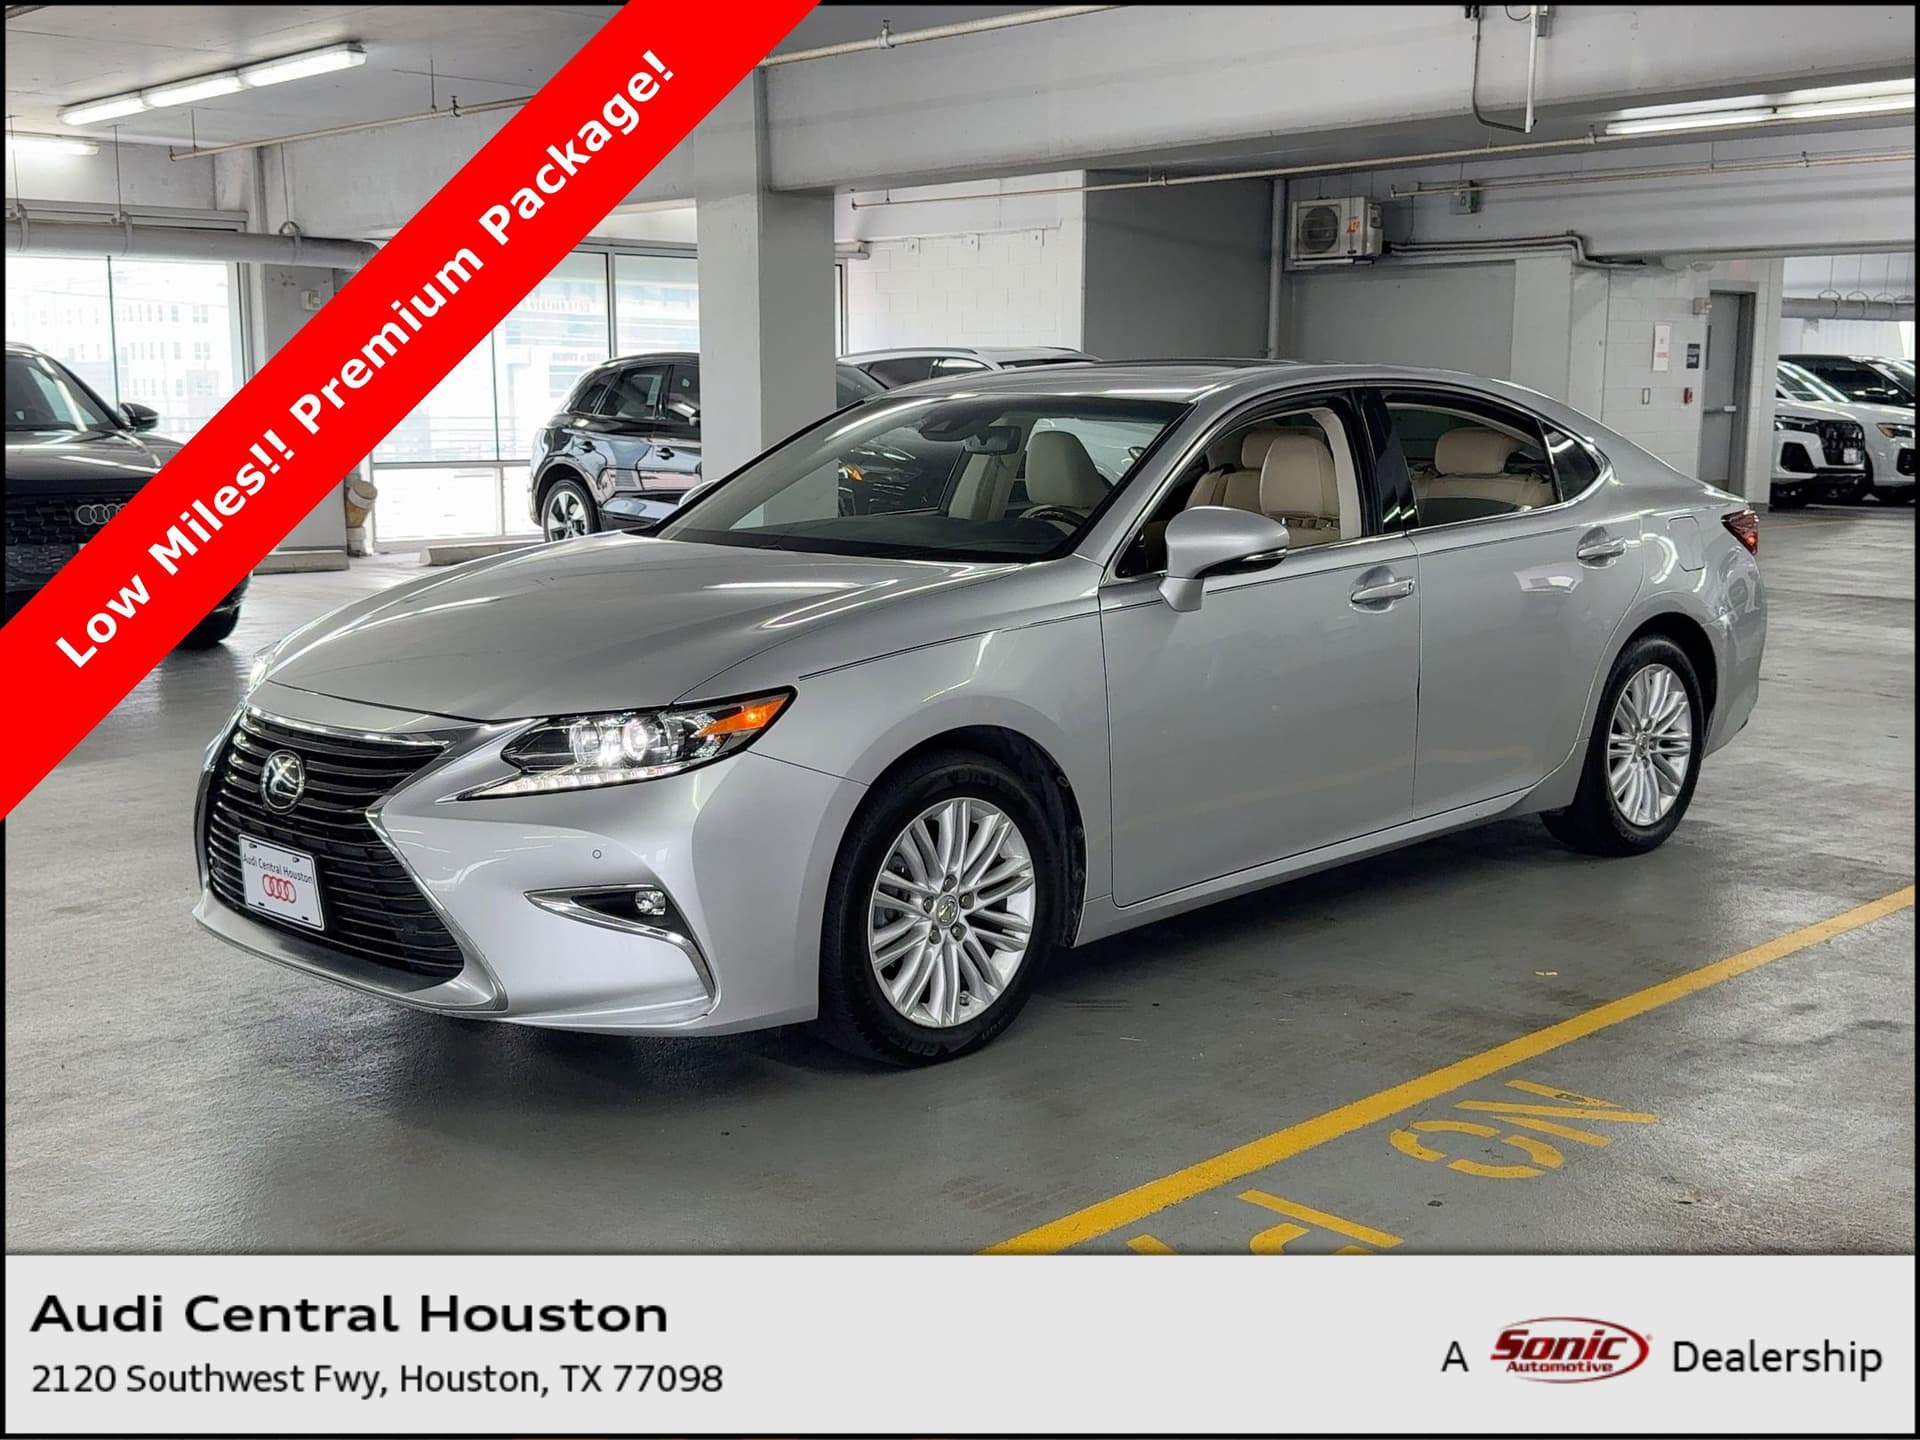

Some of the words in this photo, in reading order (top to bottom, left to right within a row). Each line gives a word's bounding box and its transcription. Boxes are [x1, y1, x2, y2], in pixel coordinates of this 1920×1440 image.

[243, 852, 258, 868] Audi
[258, 857, 282, 876] Central
[282, 865, 314, 884] Houston
